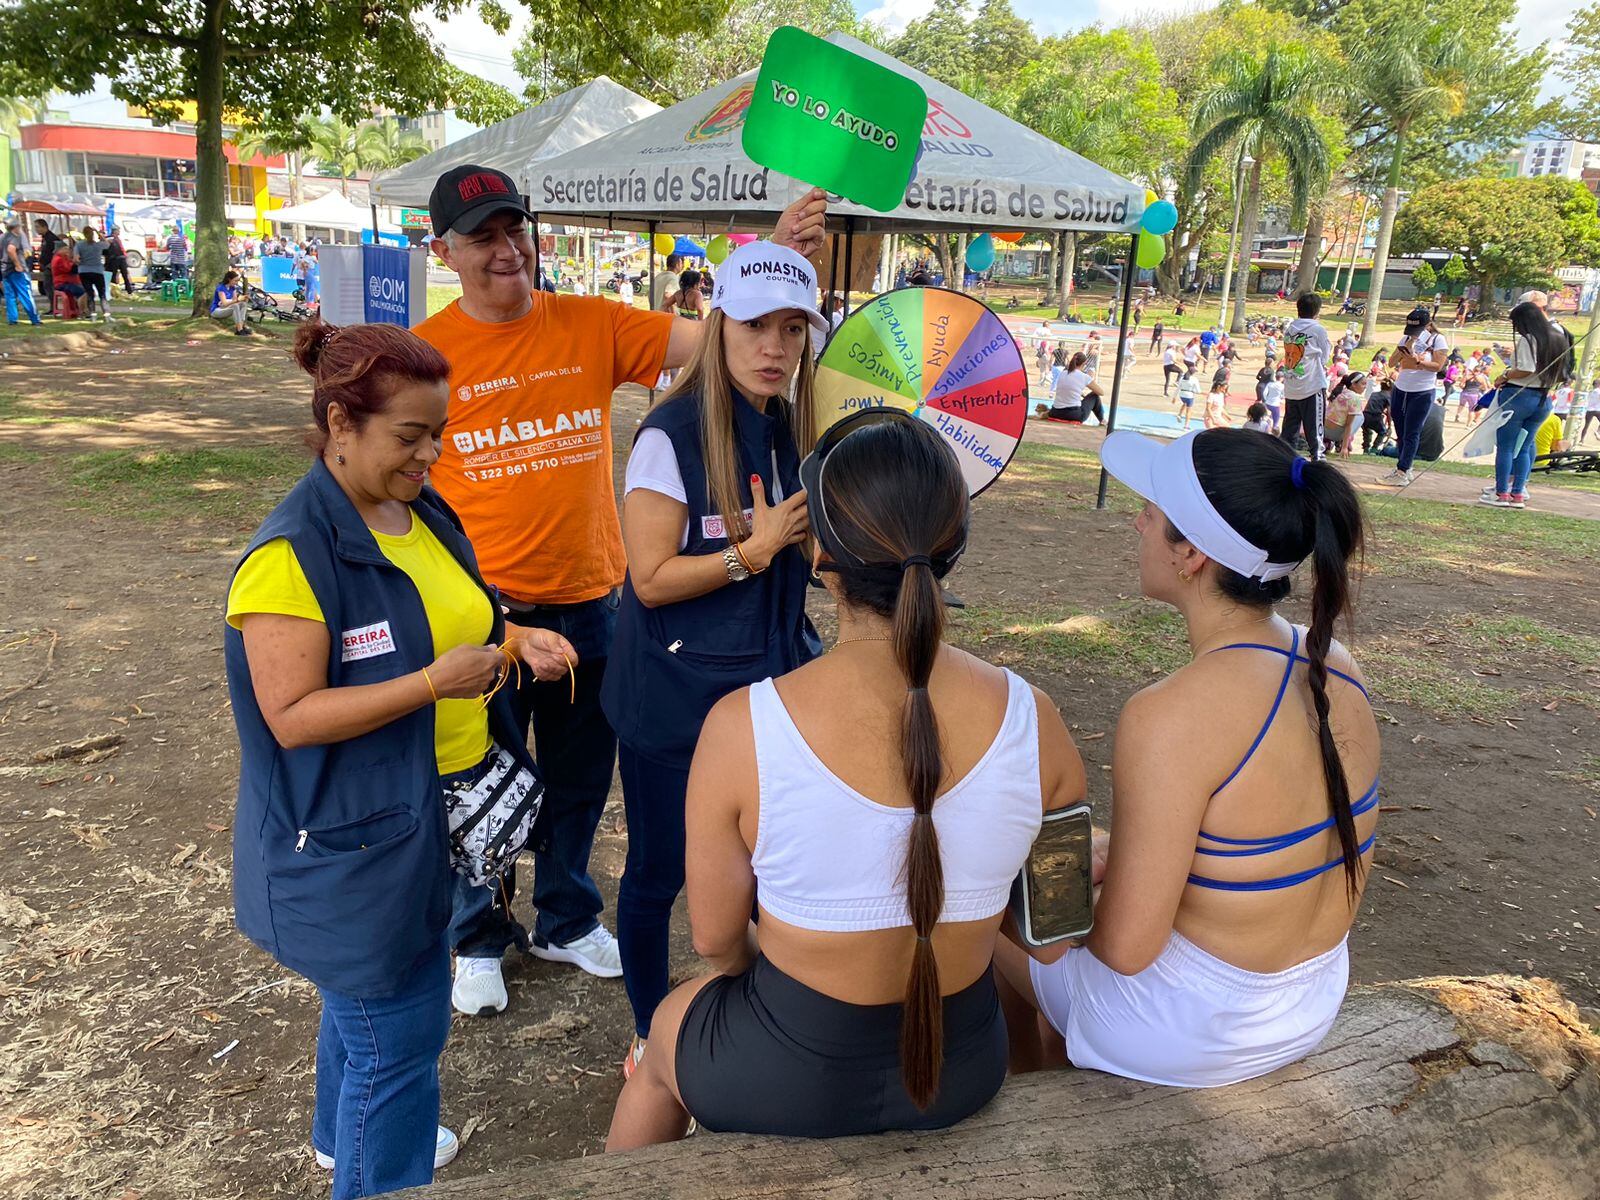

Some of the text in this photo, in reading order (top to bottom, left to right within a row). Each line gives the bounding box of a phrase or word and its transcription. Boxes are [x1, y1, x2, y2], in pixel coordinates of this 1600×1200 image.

[771, 79, 900, 152] YO LO AYUDO
[921, 140, 994, 157] ALUD
[542, 164, 769, 204] Secretaría de Salud
[905, 178, 1131, 225] etaría de Salud
[740, 261, 812, 289] MONASTERY
[766, 275, 799, 286] COUTURE
[382, 277, 405, 303] OIM
[878, 297, 922, 384] Prevención
[927, 314, 950, 367] Ayuda
[528, 366, 583, 382] CAPITAL DEL EJE
[848, 342, 903, 391] Amigos
[934, 334, 1008, 395] Soluciones
[474, 376, 517, 394] PEREIRA
[838, 395, 884, 410] Amor
[940, 392, 1021, 412] Enfrentar
[473, 408, 602, 449] HÁBLAME
[464, 452, 499, 466] ROMPER
[501, 450, 513, 461] EL
[515, 442, 555, 457] SILENCIO
[557, 437, 583, 448] SALVA
[481, 458, 559, 480] 322 861 5710
[344, 629, 388, 647] EREIRA
